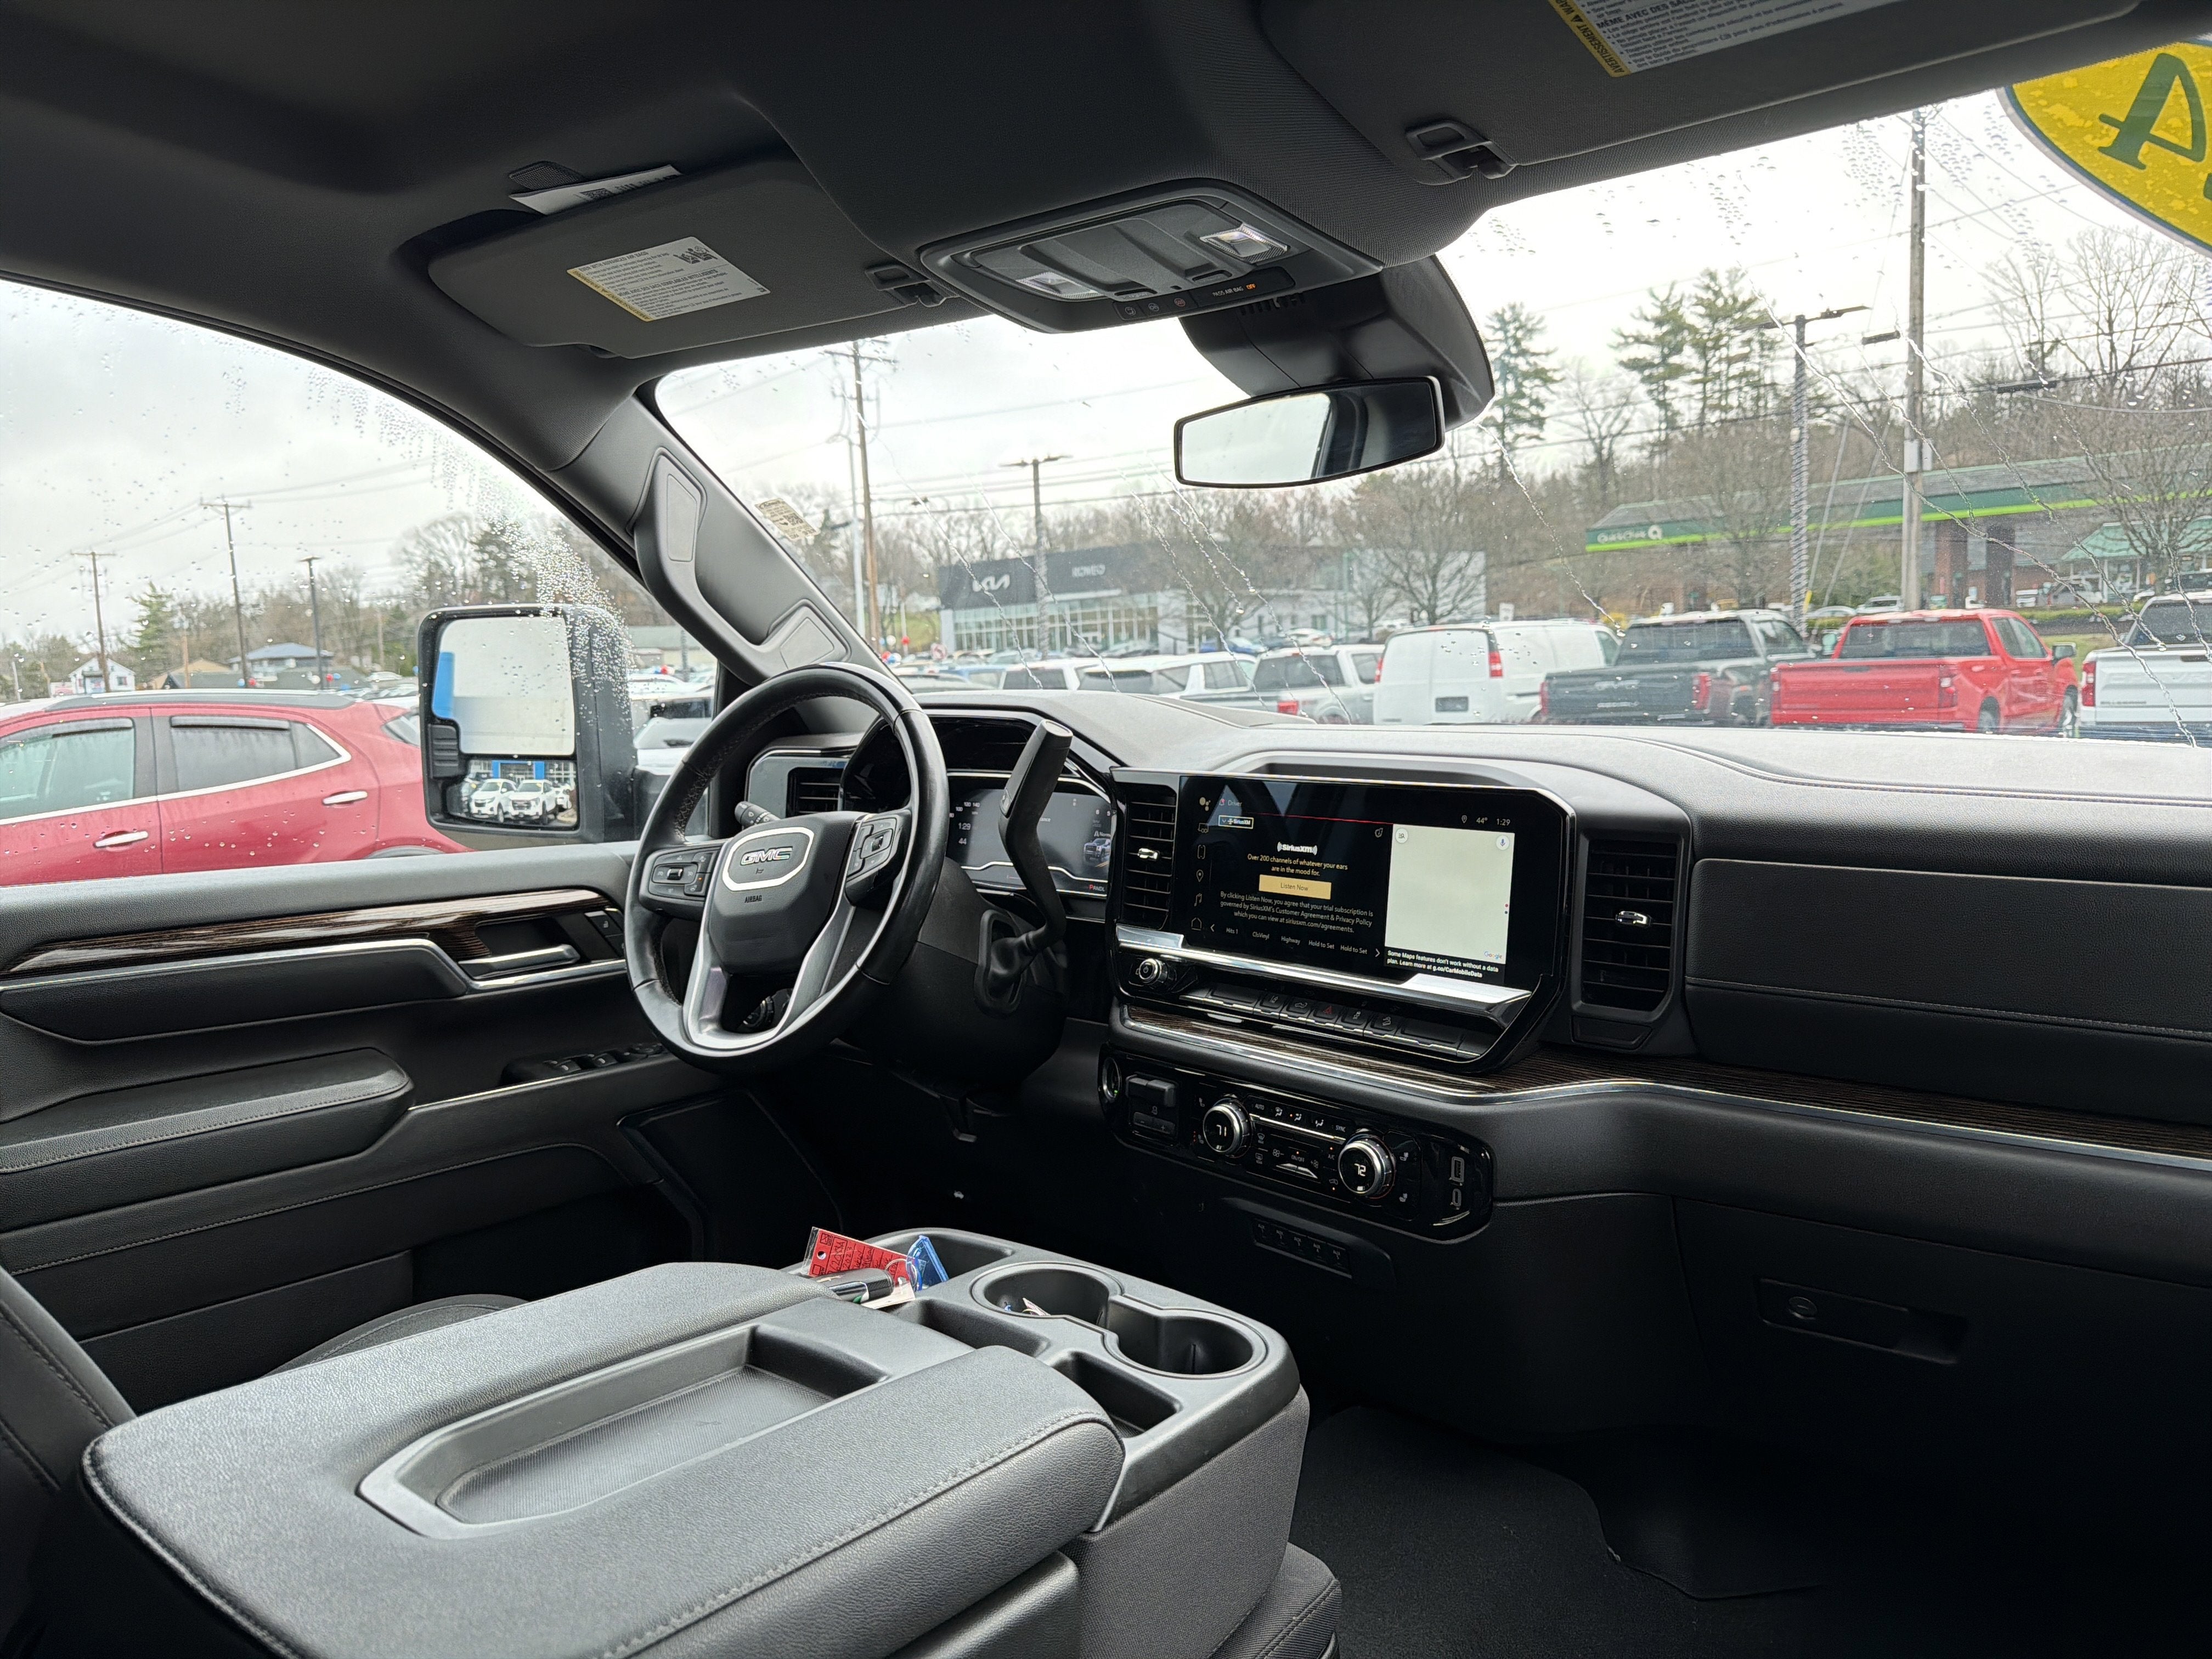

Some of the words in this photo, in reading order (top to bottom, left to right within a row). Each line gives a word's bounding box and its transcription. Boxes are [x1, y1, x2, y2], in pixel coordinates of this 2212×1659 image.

[1596, 16, 1625, 28] MÊME
[1626, 10, 1649, 21] AVEC
[1649, 3, 1669, 13] DES
[740, 845, 793, 866] GMC
[1270, 856, 1292, 865] channels
[1299, 859, 1323, 867] whatever
[1323, 862, 1335, 870] your
[744, 895, 763, 904] AIRBAG
[1227, 892, 1245, 901] clicking
[1245, 894, 1260, 902] Listen
[1261, 896, 1273, 905] Now,
[1334, 905, 1368, 916] subscription
[1220, 900, 1243, 910] governed
[1250, 904, 1275, 913] SiriusXM's
[1276, 907, 1300, 916] Customer
[1300, 911, 1329, 921] Agreement
[1335, 915, 1355, 925] Privacy
[1356, 918, 1372, 927] Policy
[1281, 935, 1301, 945] Highway
[1402, 952, 1415, 961] Maps
[1416, 954, 1436, 963] features
[1436, 957, 1449, 965] don't
[1449, 959, 1462, 967] work
[1463, 961, 1482, 970] without
[1484, 951, 1503, 960] Google
[1432, 964, 1483, 978] g.co/CarMobileData
[1335, 1125, 1346, 1133] SYNC
[1291, 1154, 1305, 1163] ON/OFF
[1354, 1163, 1366, 1177] 72
